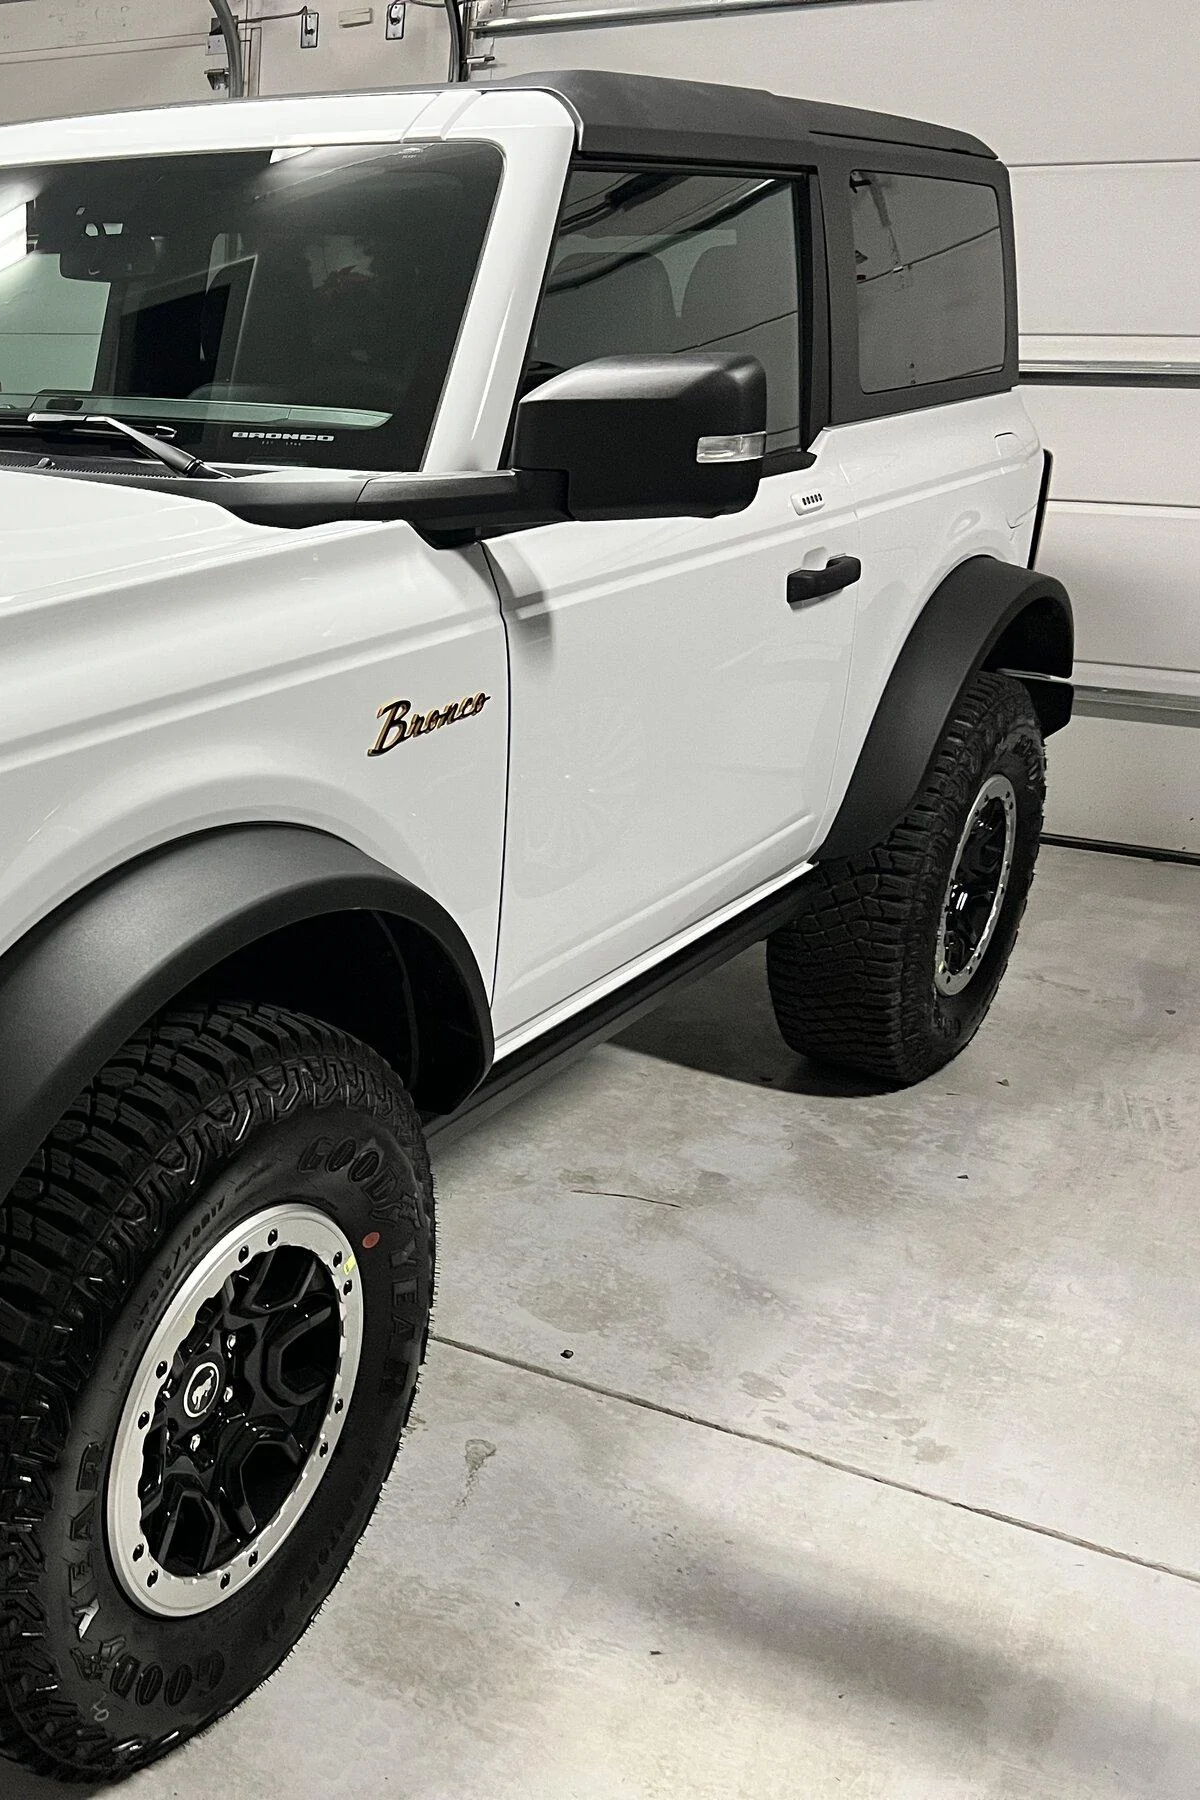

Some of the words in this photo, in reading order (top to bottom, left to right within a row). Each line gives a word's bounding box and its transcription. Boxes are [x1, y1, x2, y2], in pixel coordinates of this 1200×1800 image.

[231, 431, 335, 442] BRONCO
[367, 692, 491, 757] Bronco
[297, 1136, 422, 1397] GOODYEAR
[68, 1441, 225, 1707] GOODYEAR
